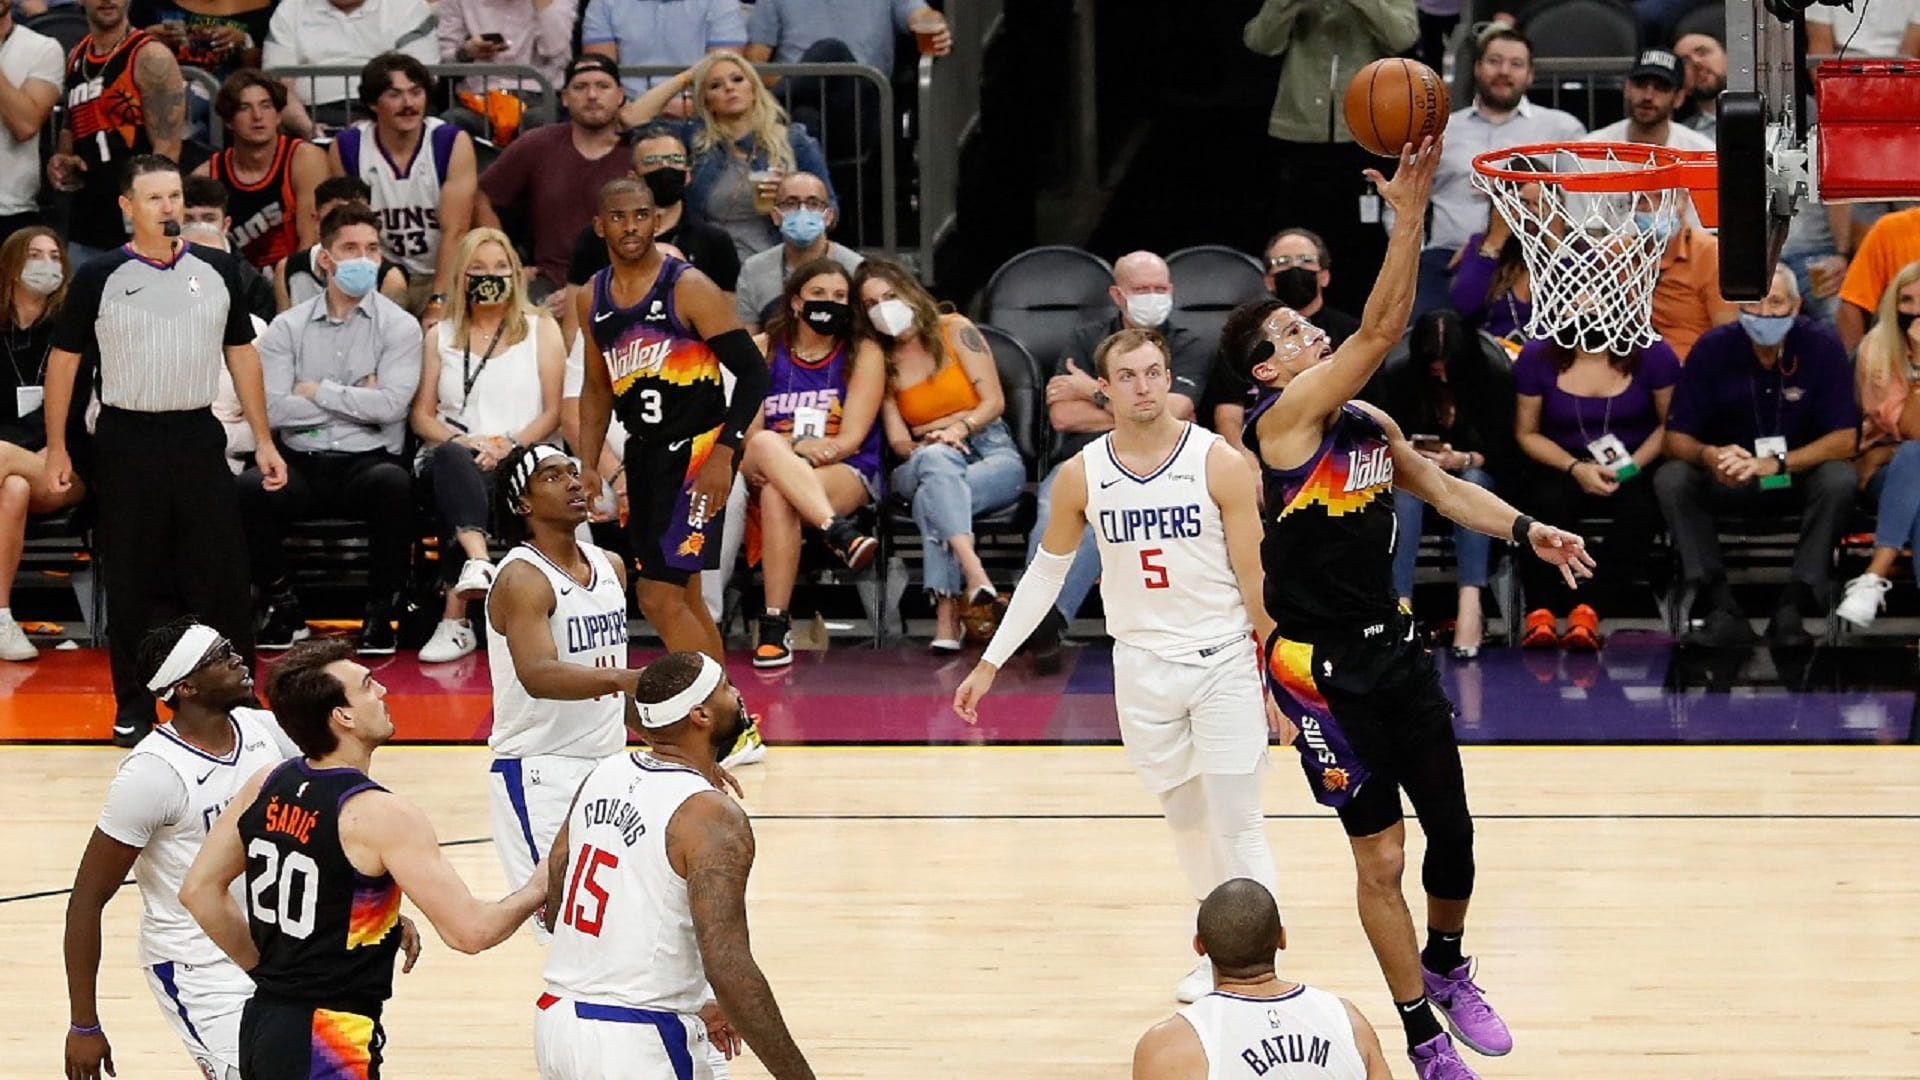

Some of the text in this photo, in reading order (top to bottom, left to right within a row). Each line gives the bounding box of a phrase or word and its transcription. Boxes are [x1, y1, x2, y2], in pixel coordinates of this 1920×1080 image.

[96, 130, 111, 162] 1
[387, 231, 428, 257] 33
[602, 338, 673, 382] Valley
[640, 389, 662, 423] 3
[1343, 445, 1392, 493] Valle
[1100, 504, 1200, 544] CLIPPERS
[1139, 548, 1169, 588] 5
[265, 795, 320, 844] ŠARIĆ
[584, 798, 646, 848] COUSINS
[248, 837, 319, 940] 20
[563, 843, 619, 938] 15
[1241, 1034, 1331, 1077] BATUM
